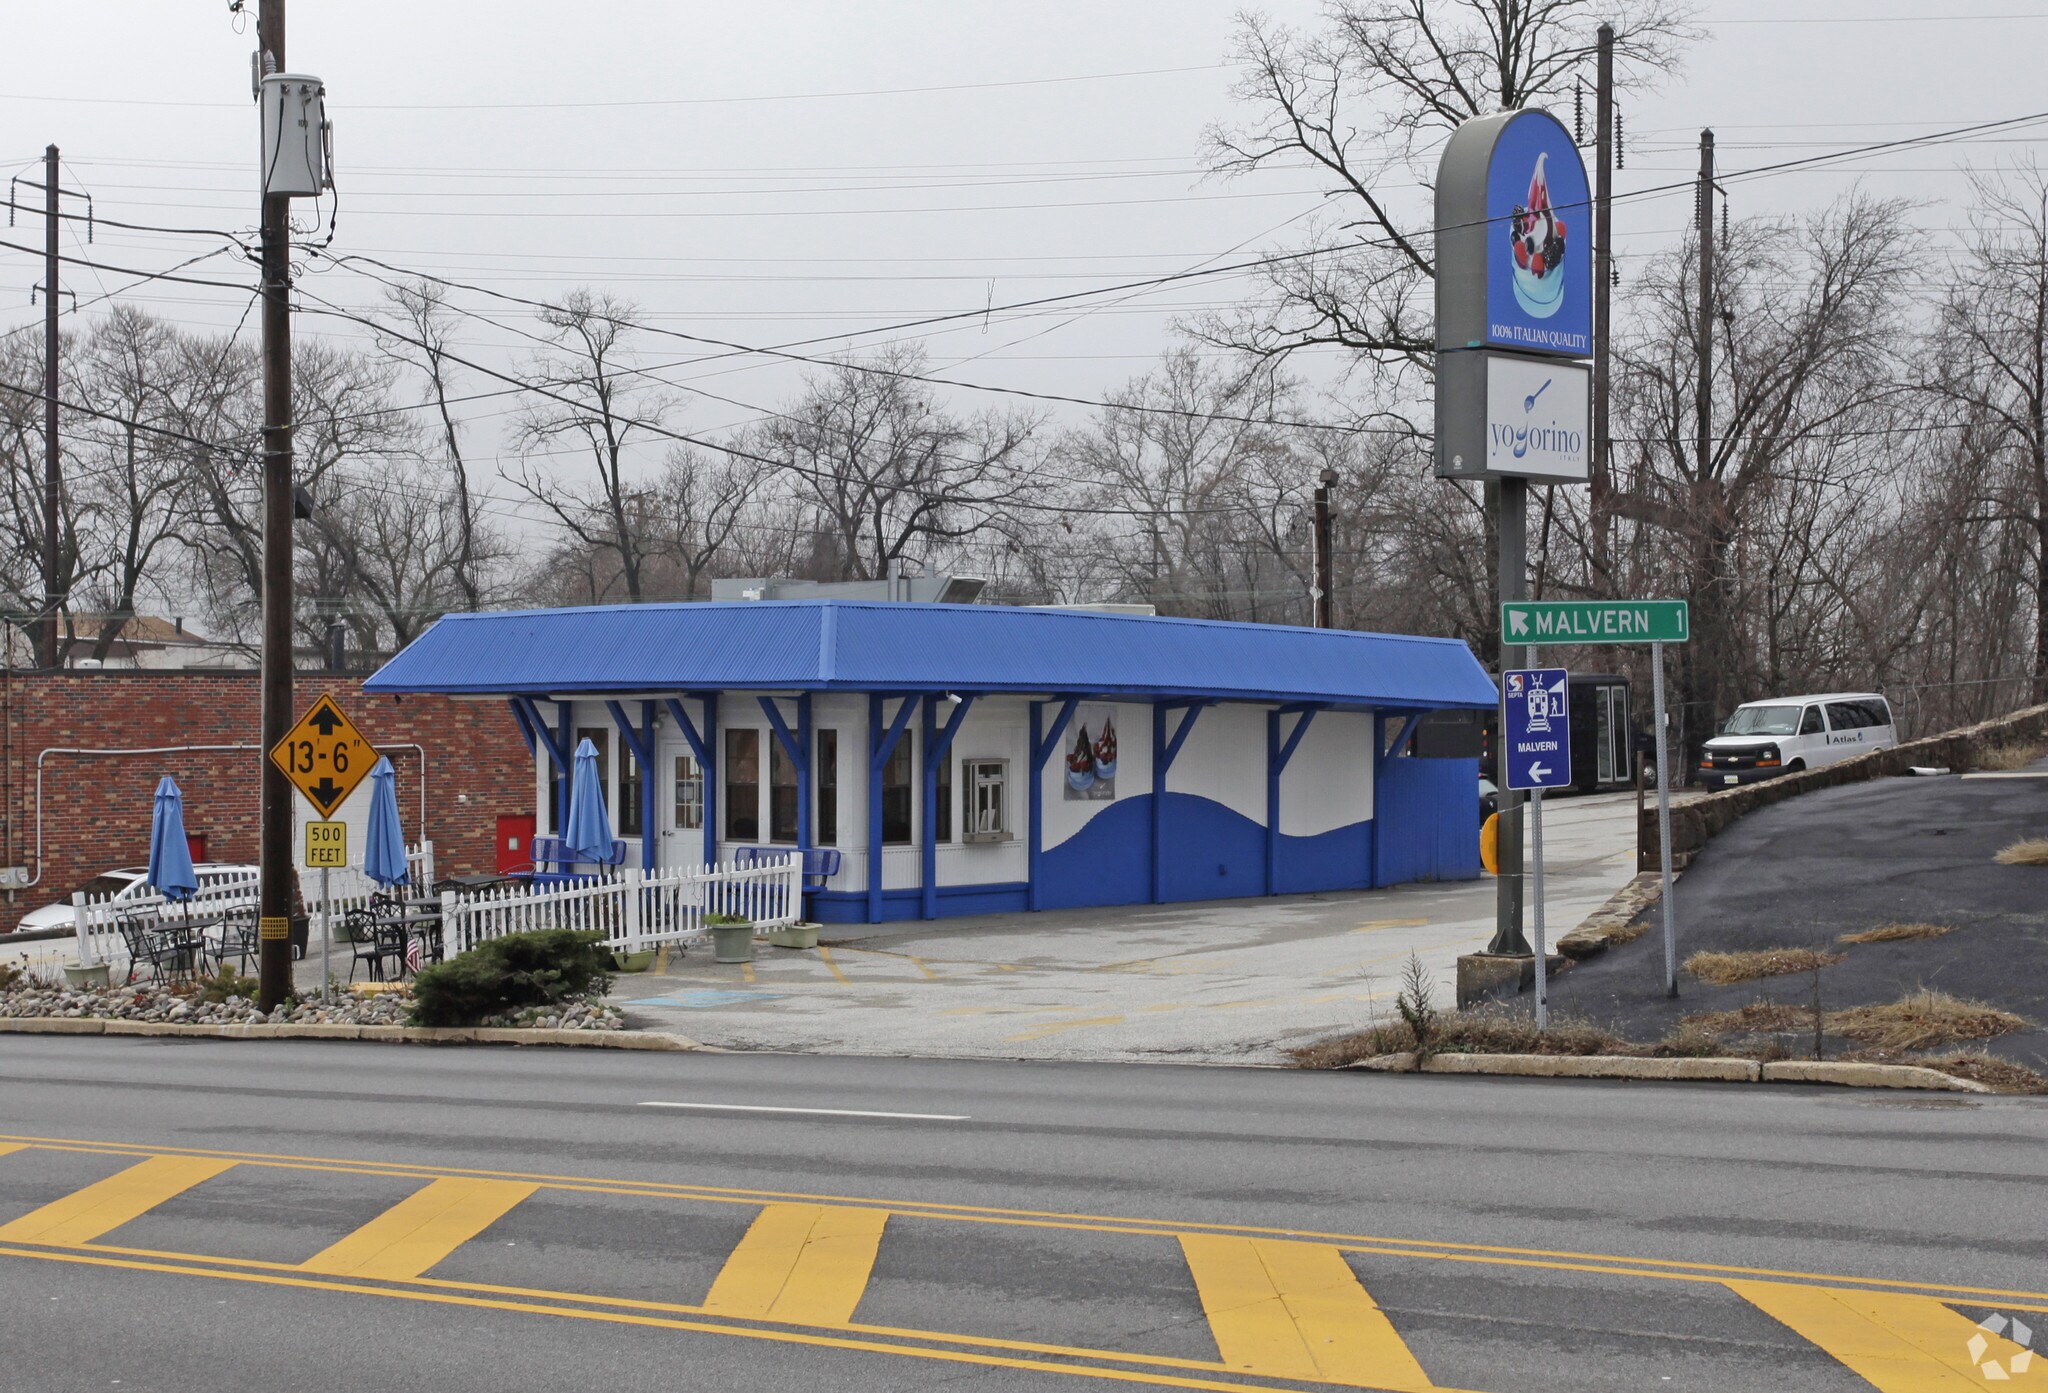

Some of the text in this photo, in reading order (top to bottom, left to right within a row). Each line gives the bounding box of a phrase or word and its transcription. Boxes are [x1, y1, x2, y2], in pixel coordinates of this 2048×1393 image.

[1492, 323, 1587, 348] 100% ITALIAN QUALITY
[1491, 420, 1581, 459] yogorino
[1536, 609, 1683, 635] MALVERN 1
[1518, 741, 1558, 752] MALVERN
[1833, 735, 1856, 743] Atlas
[312, 827, 341, 842] 500
[311, 848, 341, 862] FEET
